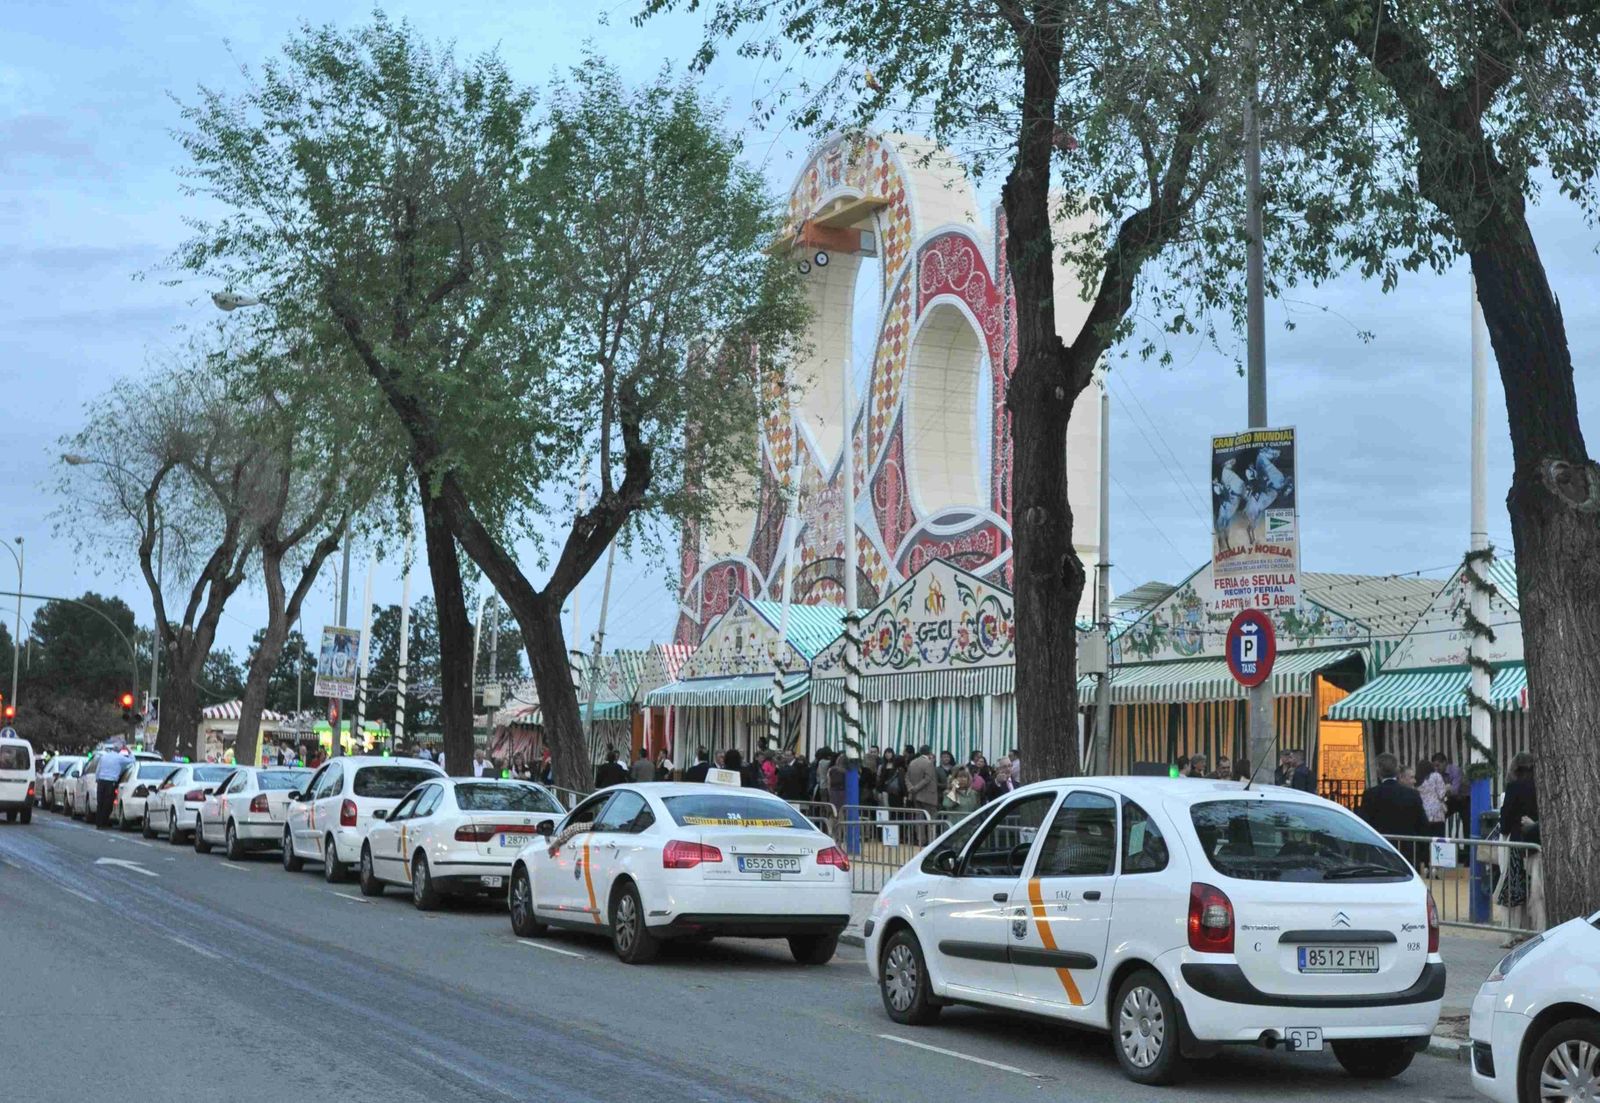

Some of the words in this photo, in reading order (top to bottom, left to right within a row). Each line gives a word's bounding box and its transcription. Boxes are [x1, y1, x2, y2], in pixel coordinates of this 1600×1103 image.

[1214, 437, 1233, 448] GRAN
[1235, 434, 1252, 445] CIRCO
[1254, 431, 1293, 442] MUNDIAL
[1215, 545, 1246, 562] NATALIA
[1255, 544, 1292, 558] NOELIA
[1215, 577, 1238, 589] FERIA
[1240, 577, 1249, 587] de
[1252, 574, 1295, 586] SEVILLA
[1224, 587, 1251, 596] RECINTO
[1254, 586, 1285, 594] FERIAL
[1215, 601, 1220, 610] A
[1222, 597, 1243, 609] PARTIR
[1255, 593, 1270, 606] 15
[1274, 594, 1296, 606] ABRIL
[917, 620, 952, 643] GECI
[1244, 639, 1254, 657] P
[1241, 663, 1256, 673] TAXIS
[746, 858, 774, 869] 6526
[777, 858, 797, 869] GPP
[483, 876, 500, 887] SP
[1056, 890, 1071, 900] TAXI
[1254, 942, 1262, 952] C
[1407, 942, 1420, 951] 928
[1308, 949, 1345, 966] 8512
[1349, 950, 1376, 966] FYH
[1291, 1031, 1318, 1048] SP
